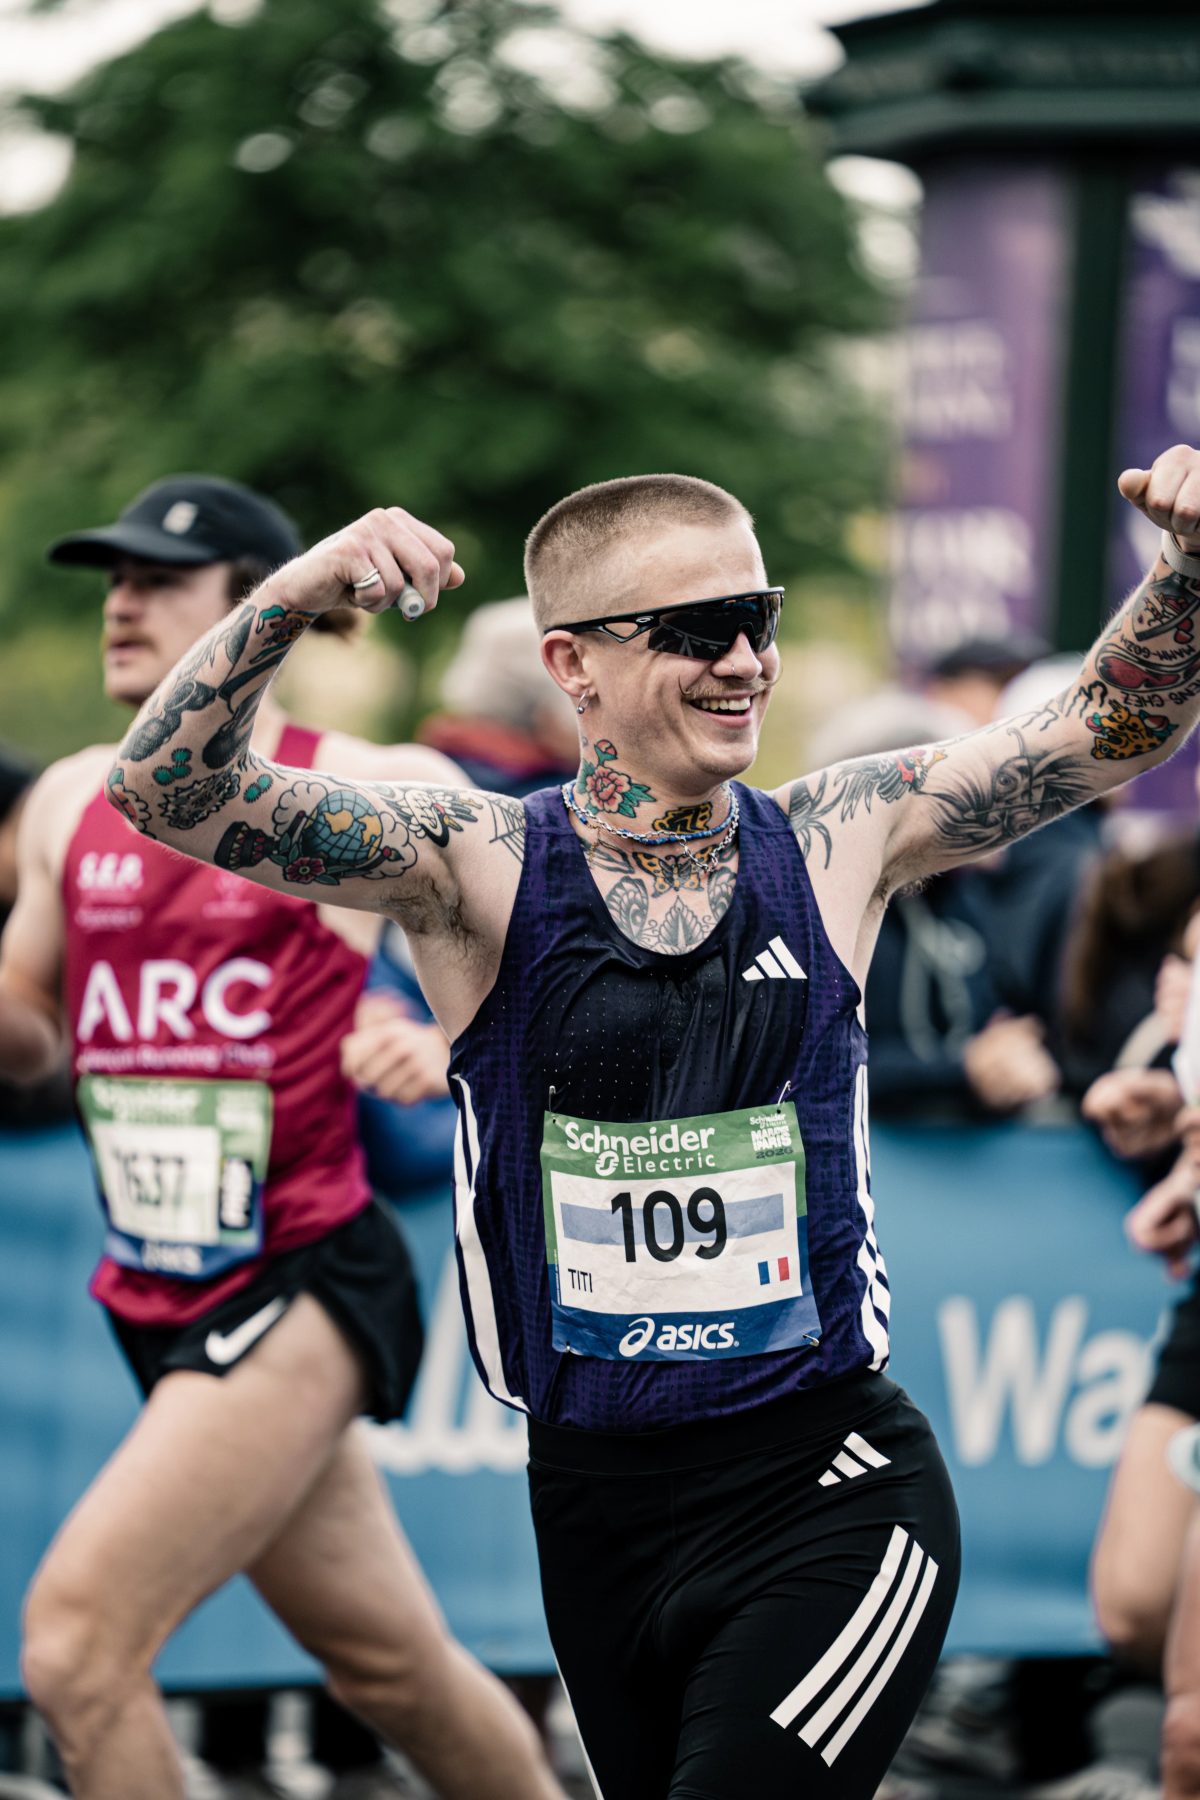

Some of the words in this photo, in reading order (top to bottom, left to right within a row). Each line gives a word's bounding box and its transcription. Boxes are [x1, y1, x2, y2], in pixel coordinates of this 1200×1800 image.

[1120, 691, 1165, 708] CHEZ
[77, 957, 273, 1043] ARC
[564, 1122, 715, 1156] Schneider
[624, 1153, 716, 1174] Electric
[611, 1187, 728, 1263] 109
[567, 1268, 593, 1293] TITI
